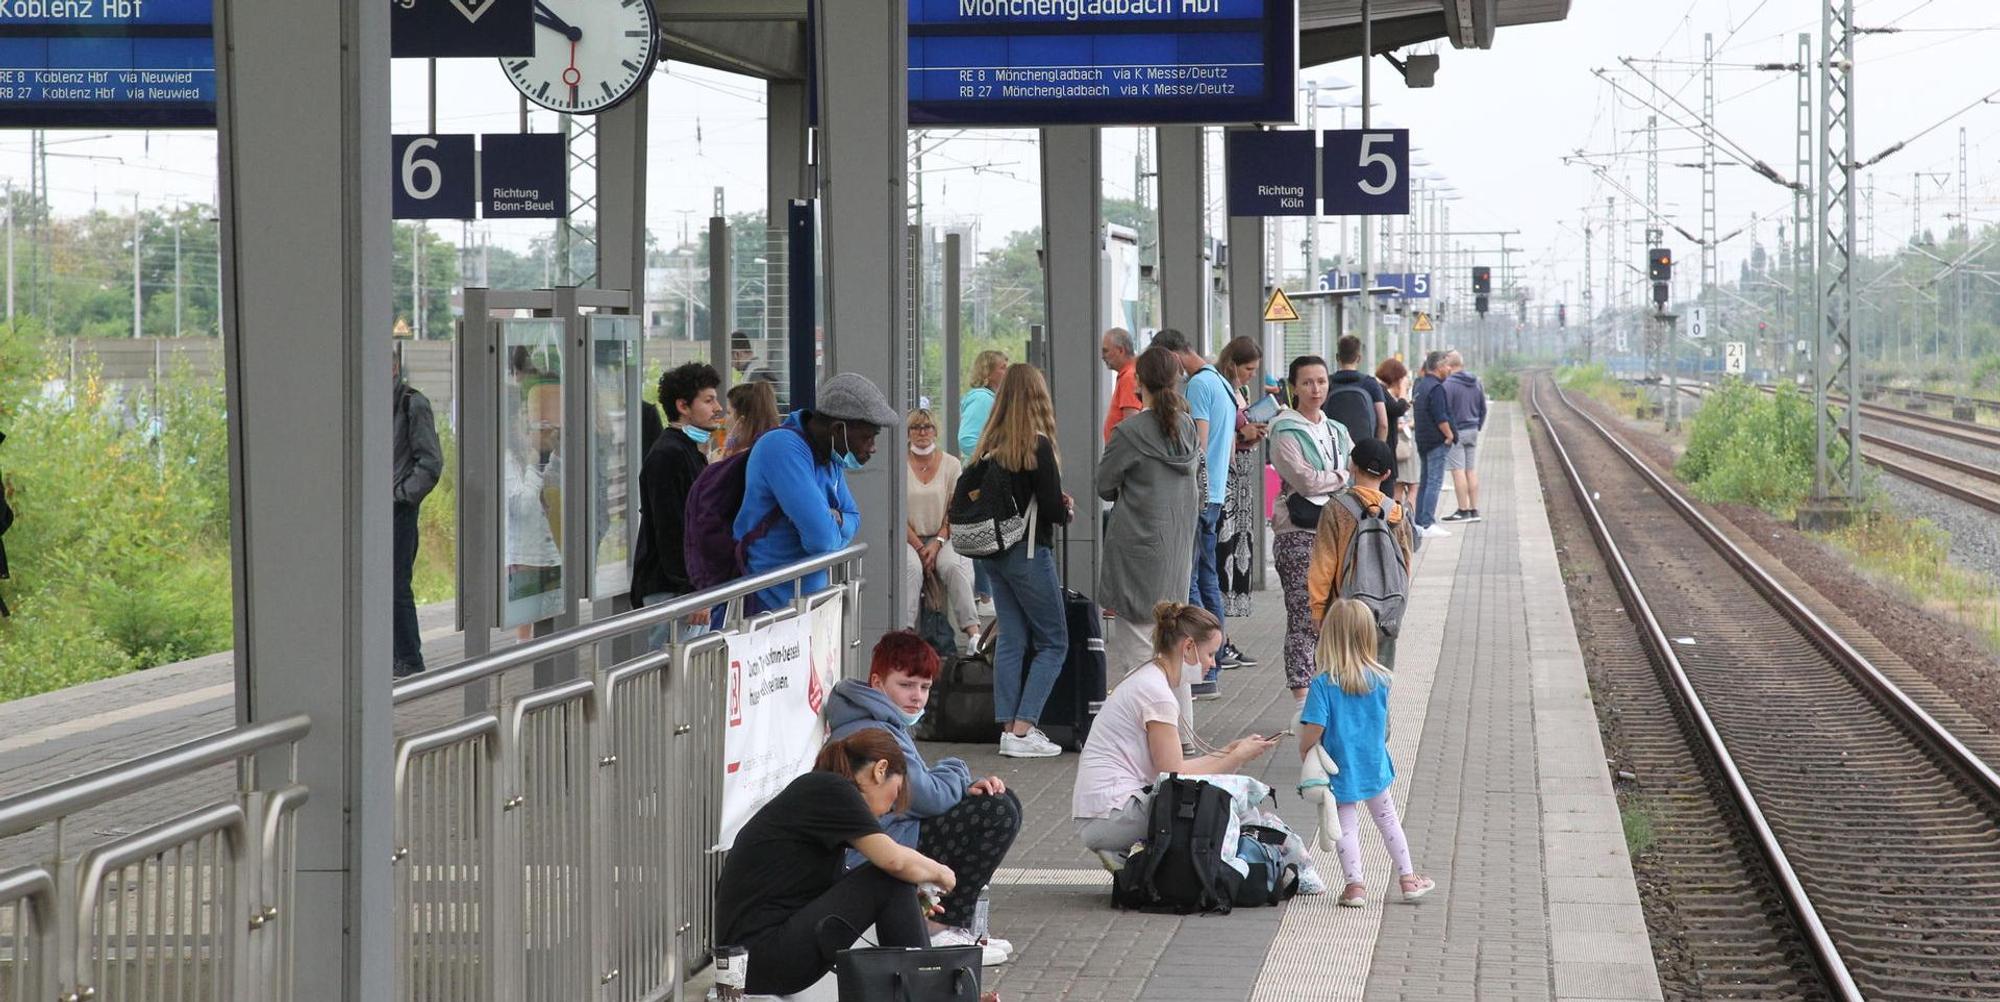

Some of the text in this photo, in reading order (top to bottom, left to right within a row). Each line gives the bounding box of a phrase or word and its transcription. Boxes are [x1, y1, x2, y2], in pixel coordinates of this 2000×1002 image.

[0, 0, 142, 18] Koblenz Hbf
[0, 71, 192, 83] RE 8 Koblenz Hbf via Neuwied
[960, 67, 1228, 82] RE 8 Mönchengladbach via K Messe/Deutz
[0, 87, 200, 99] RB 27 Koblenz Hbf via Neuwied
[960, 82, 1235, 98] RB 27 Mönchengladbach via K Messe/Deutz
[401, 138, 442, 200] 6
[1357, 133, 1397, 195] 5
[493, 188, 538, 199] Richtung
[1258, 186, 1304, 198] Richtung
[493, 201, 554, 211] Bonn-Beuel
[1280, 197, 1304, 208] Köln
[1318, 274, 1330, 290] 6
[1414, 274, 1427, 293] 5
[1694, 310, 1699, 320] 1
[1692, 323, 1701, 336] 0
[1728, 344, 1744, 356] 21
[1732, 358, 1740, 369] 4
